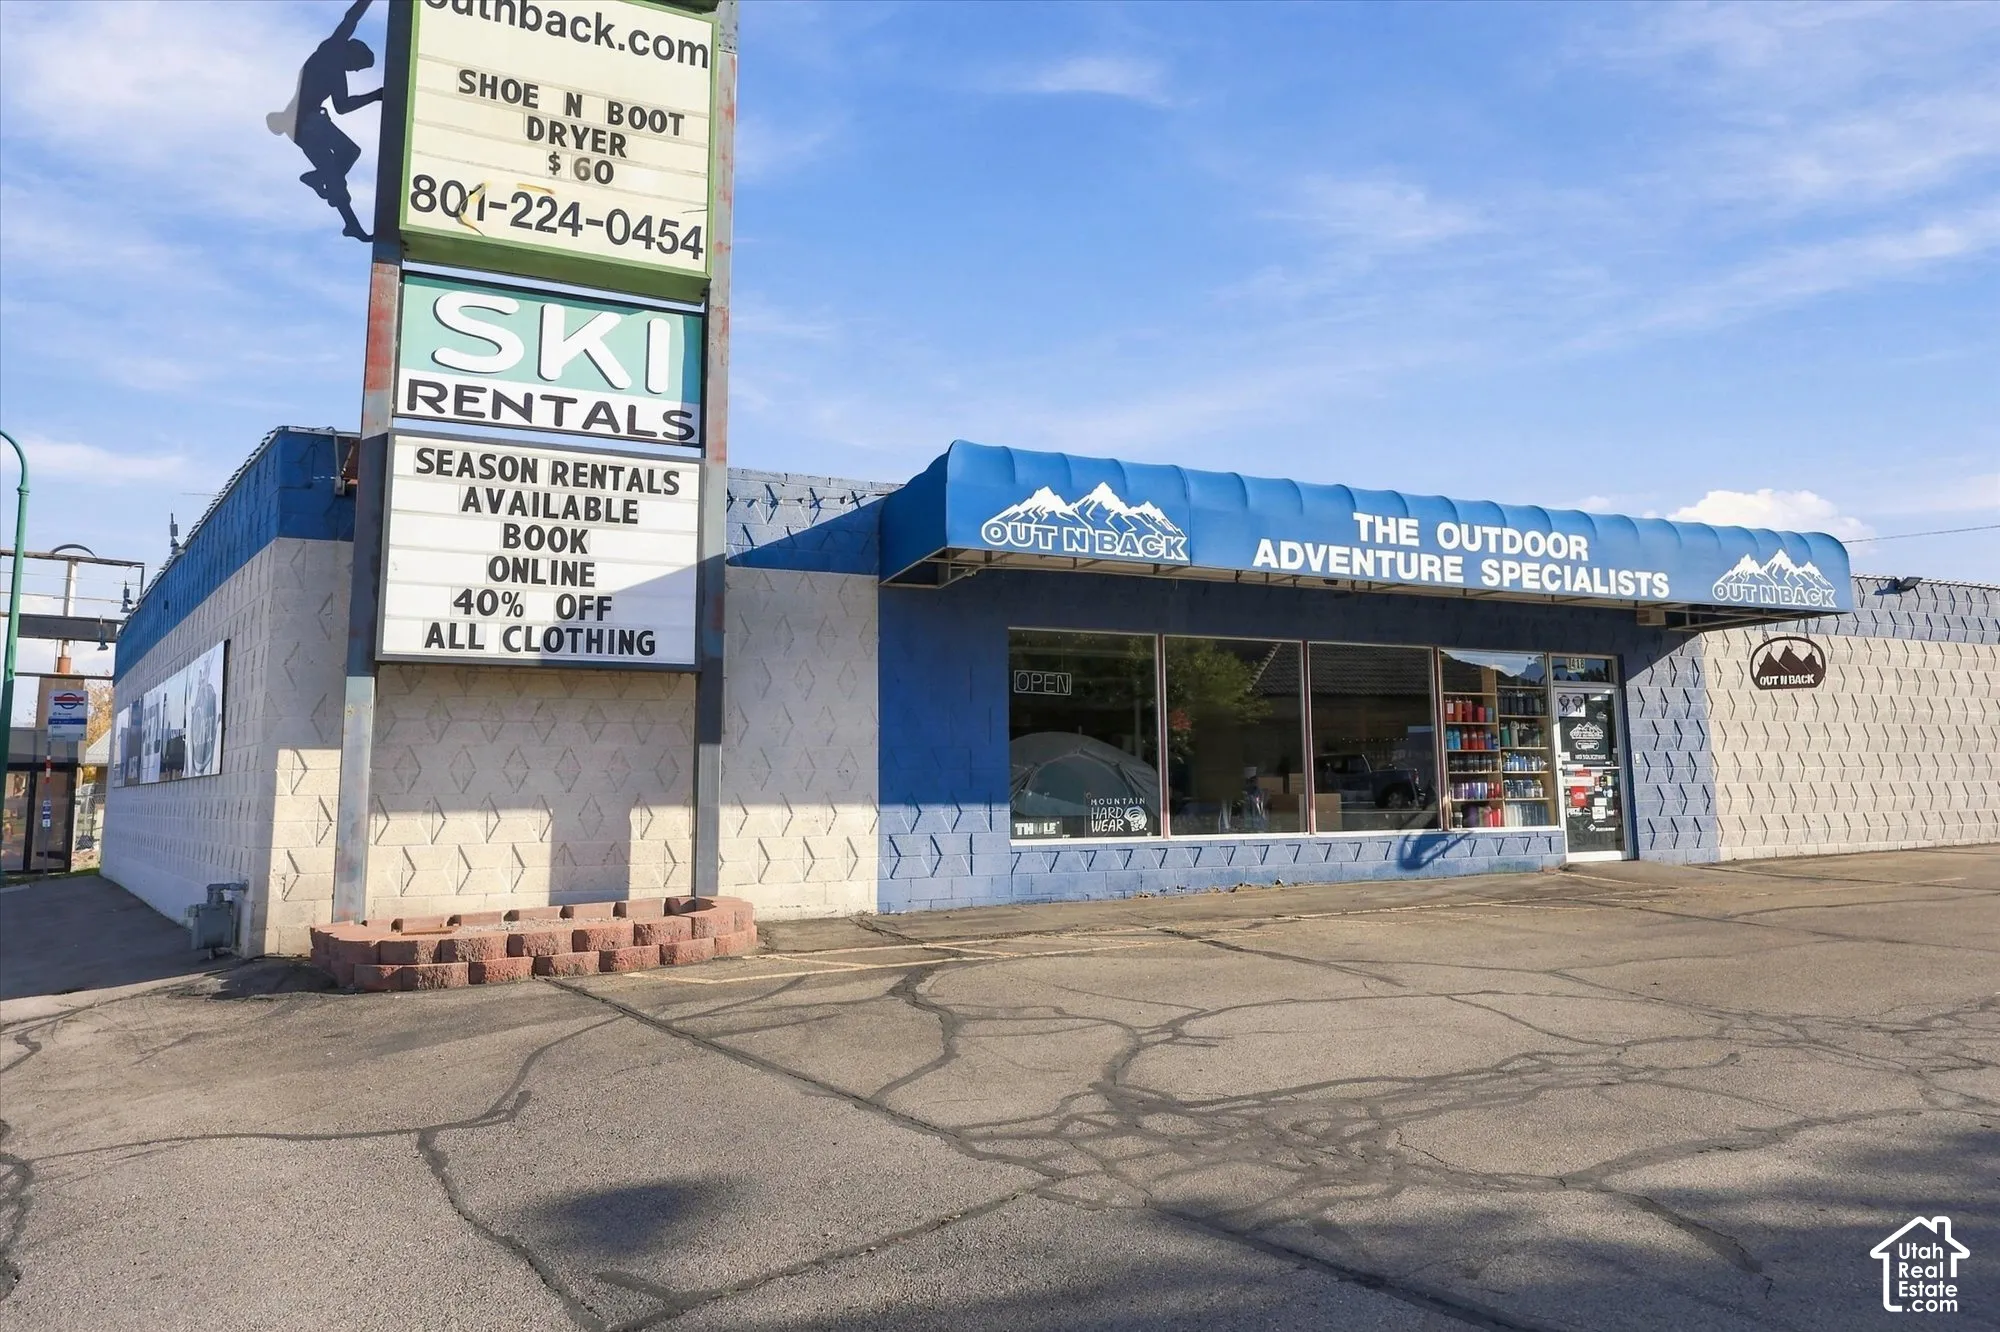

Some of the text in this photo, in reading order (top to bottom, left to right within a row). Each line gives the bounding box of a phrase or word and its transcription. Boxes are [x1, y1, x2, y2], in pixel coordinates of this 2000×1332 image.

[458, 69, 685, 137] SHOE N BOOT
[526, 116, 628, 158] DRYER
[410, 174, 704, 260] 801-224-0454
[432, 290, 671, 395] SKI
[407, 378, 695, 441] RENTALS
[416, 447, 680, 496] SEASON RENTALS
[460, 487, 638, 524] AVAILABLE
[502, 523, 589, 555] BOOK
[981, 520, 1189, 562] OUT N BACK
[1353, 512, 1589, 562] THE OUTDOOR
[488, 555, 595, 588] ONLINE
[1252, 538, 1670, 599] ADVENTURE SPECIALISTS
[453, 589, 613, 621] 40% OFF
[1712, 582, 1837, 608] OUT N BACK
[424, 622, 656, 656] ALL CLOTHING
[1017, 672, 1069, 694] OPEN
[1760, 673, 1815, 686] OUT N BACK
[1090, 797, 1146, 806] MOUNTAIN
[1091, 806, 1123, 820] HARD
[1091, 819, 1125, 832] WEAR
